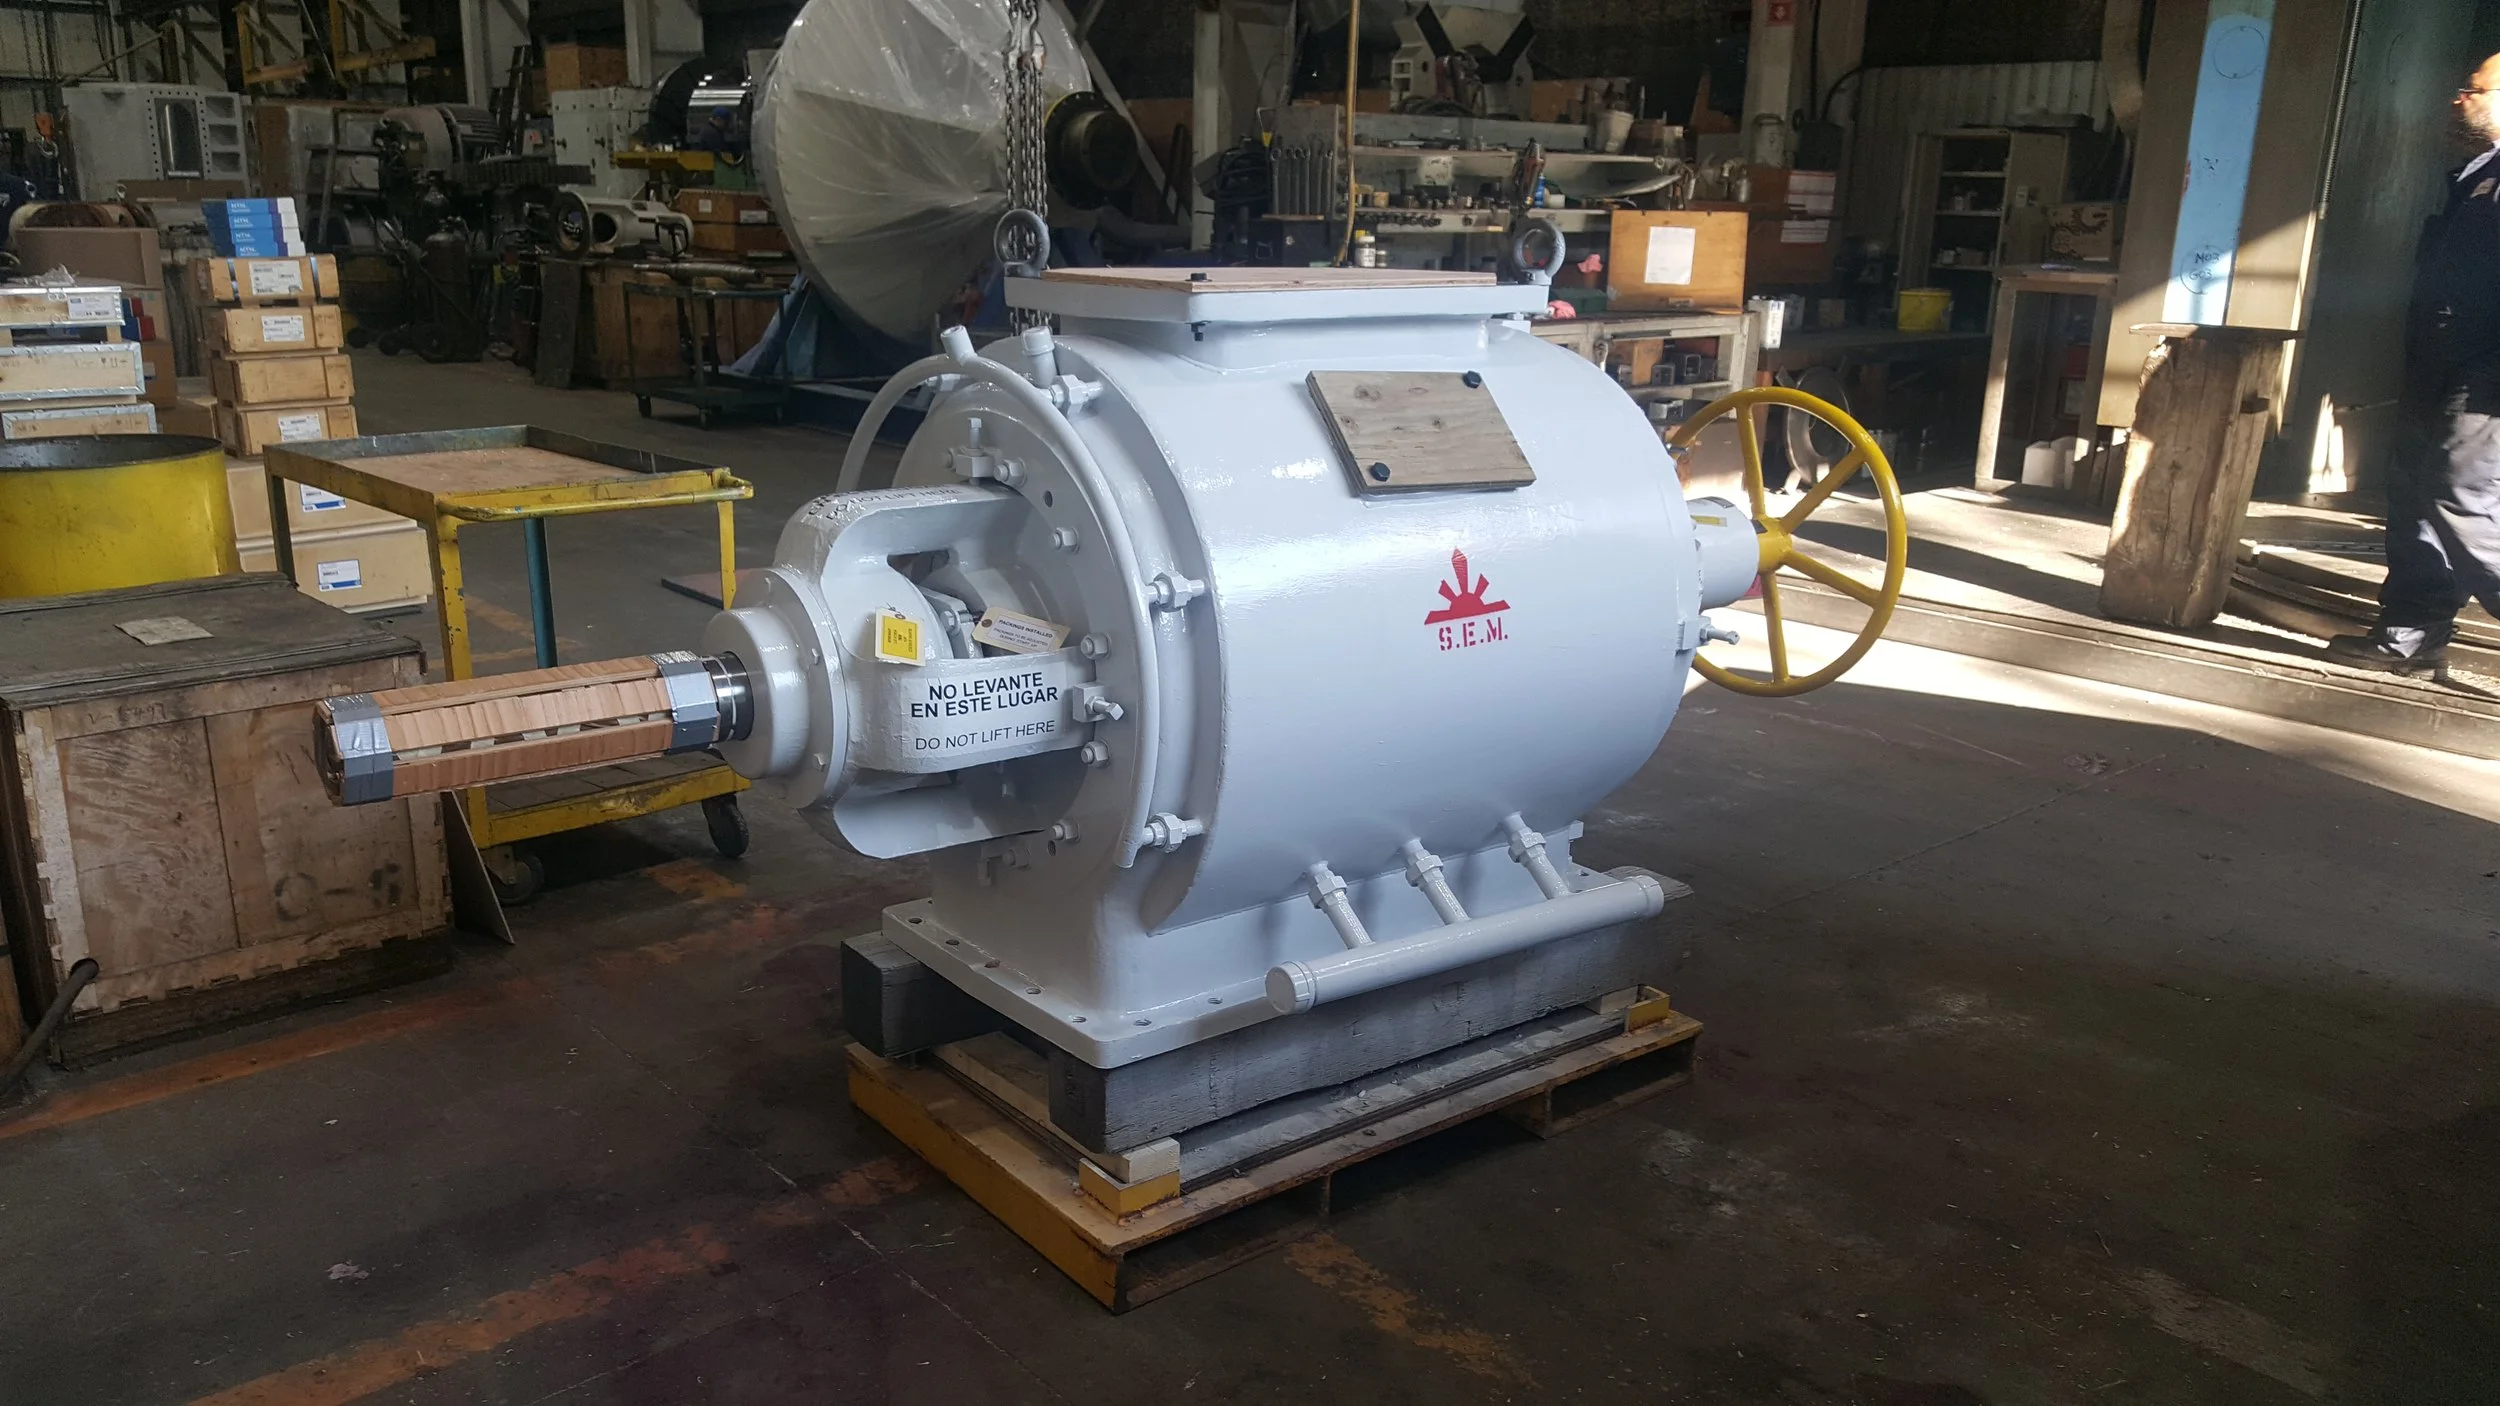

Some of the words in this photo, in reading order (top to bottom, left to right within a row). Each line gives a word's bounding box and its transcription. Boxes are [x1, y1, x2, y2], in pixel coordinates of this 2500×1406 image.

[1025, 627, 1054, 639] INSTALLED
[1439, 616, 1508, 651] S.E.M.
[929, 684, 957, 700] NO
[963, 671, 1043, 698] LEVANTE
[911, 702, 938, 718] EN
[946, 696, 992, 717] ESTE
[998, 686, 1059, 709] LUGAR
[915, 737, 941, 750] DO
[945, 732, 978, 749] NOT
[982, 727, 1012, 743] LIFT
[1016, 720, 1055, 738] HERE
